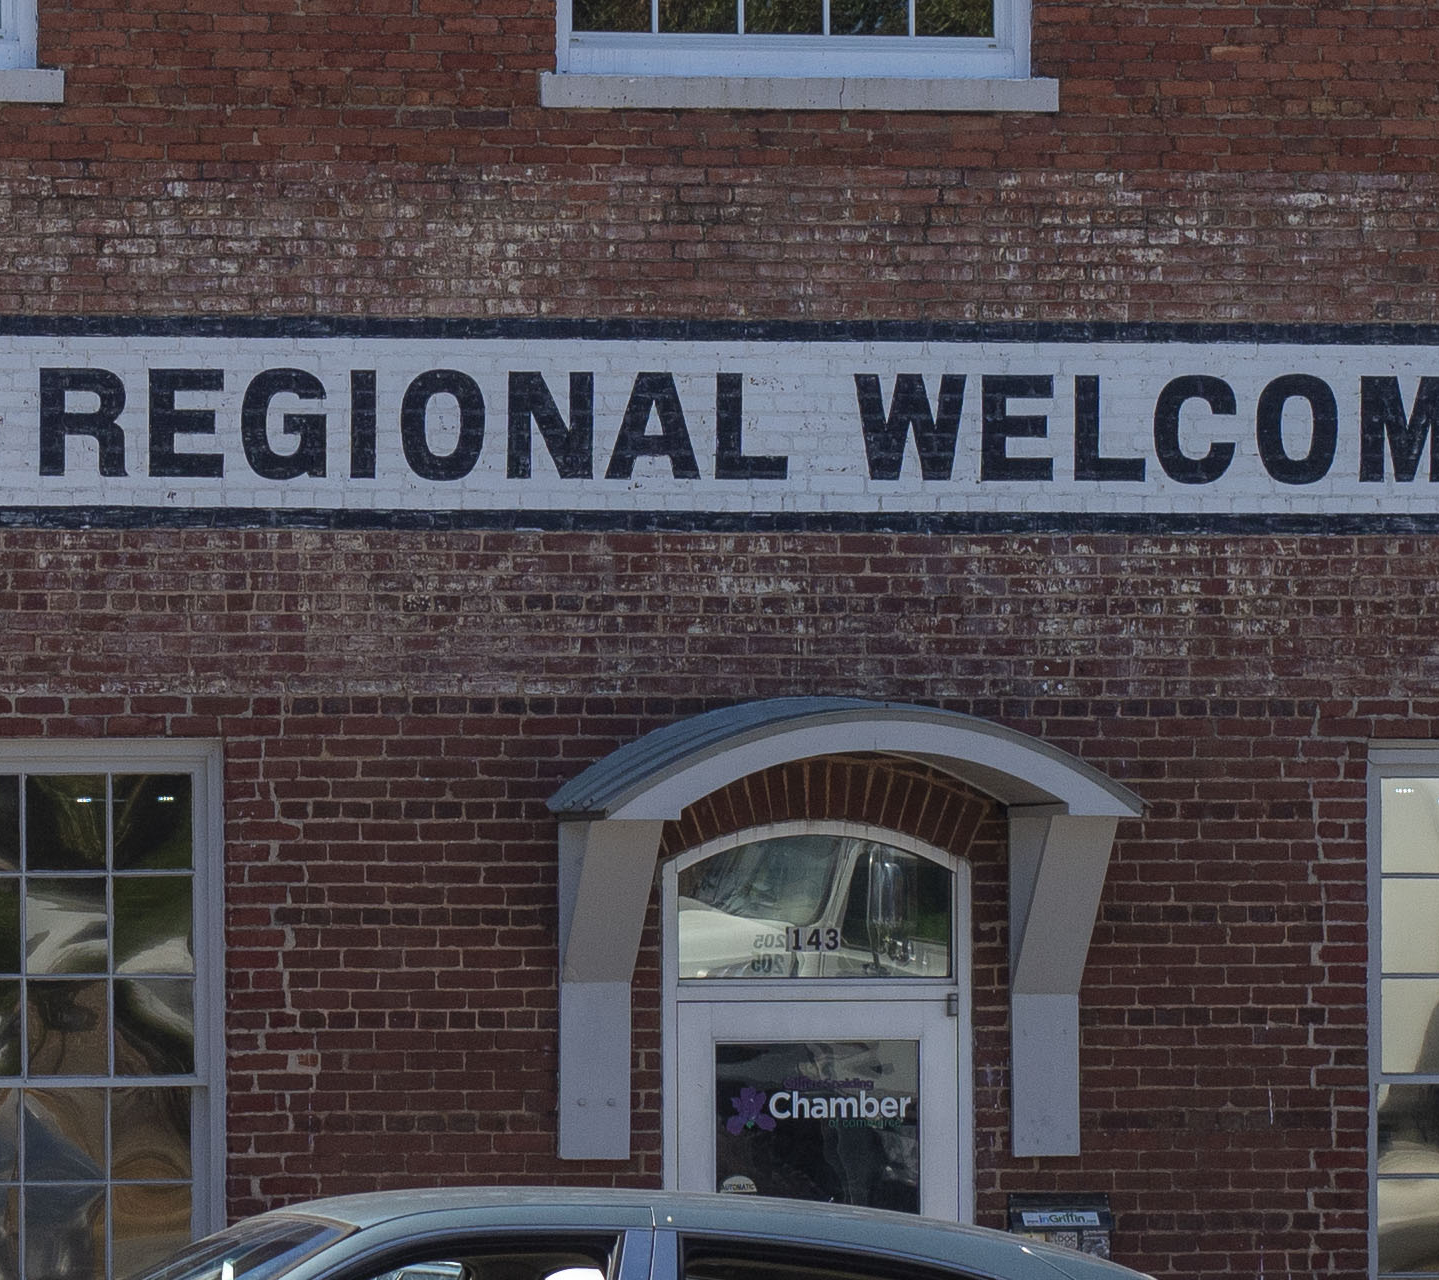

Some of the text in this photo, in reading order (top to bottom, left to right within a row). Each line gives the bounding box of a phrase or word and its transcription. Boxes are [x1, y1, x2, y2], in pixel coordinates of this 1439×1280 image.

[38, 367, 788, 482] REGIONAL
[791, 927, 840, 951] 143
[769, 1090, 912, 1119] Chamber
[828, 1119, 838, 1129] of
